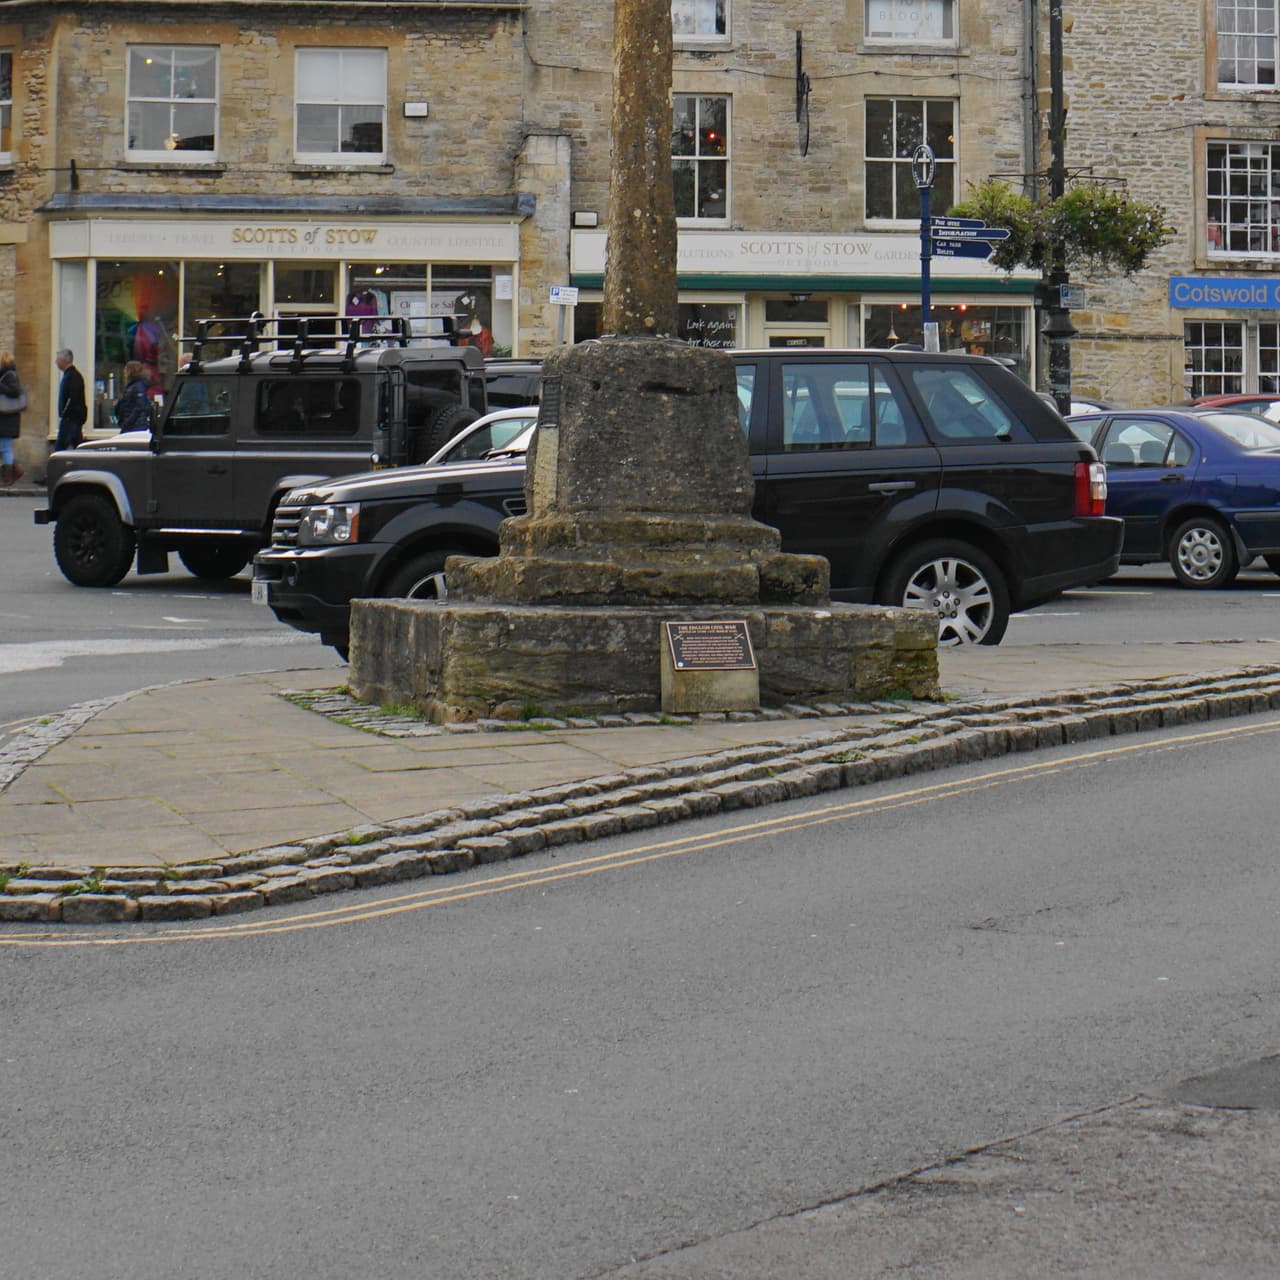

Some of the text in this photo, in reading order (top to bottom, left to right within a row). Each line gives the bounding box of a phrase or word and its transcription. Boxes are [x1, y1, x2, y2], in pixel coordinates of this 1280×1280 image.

[232, 227, 378, 244] SCOTTS of STOW
[740, 241, 804, 255] SCOTTS
[807, 241, 818, 257] of
[823, 242, 872, 256] STOW
[1175, 282, 1268, 303] Cotswold
[687, 319, 705, 330] Look
